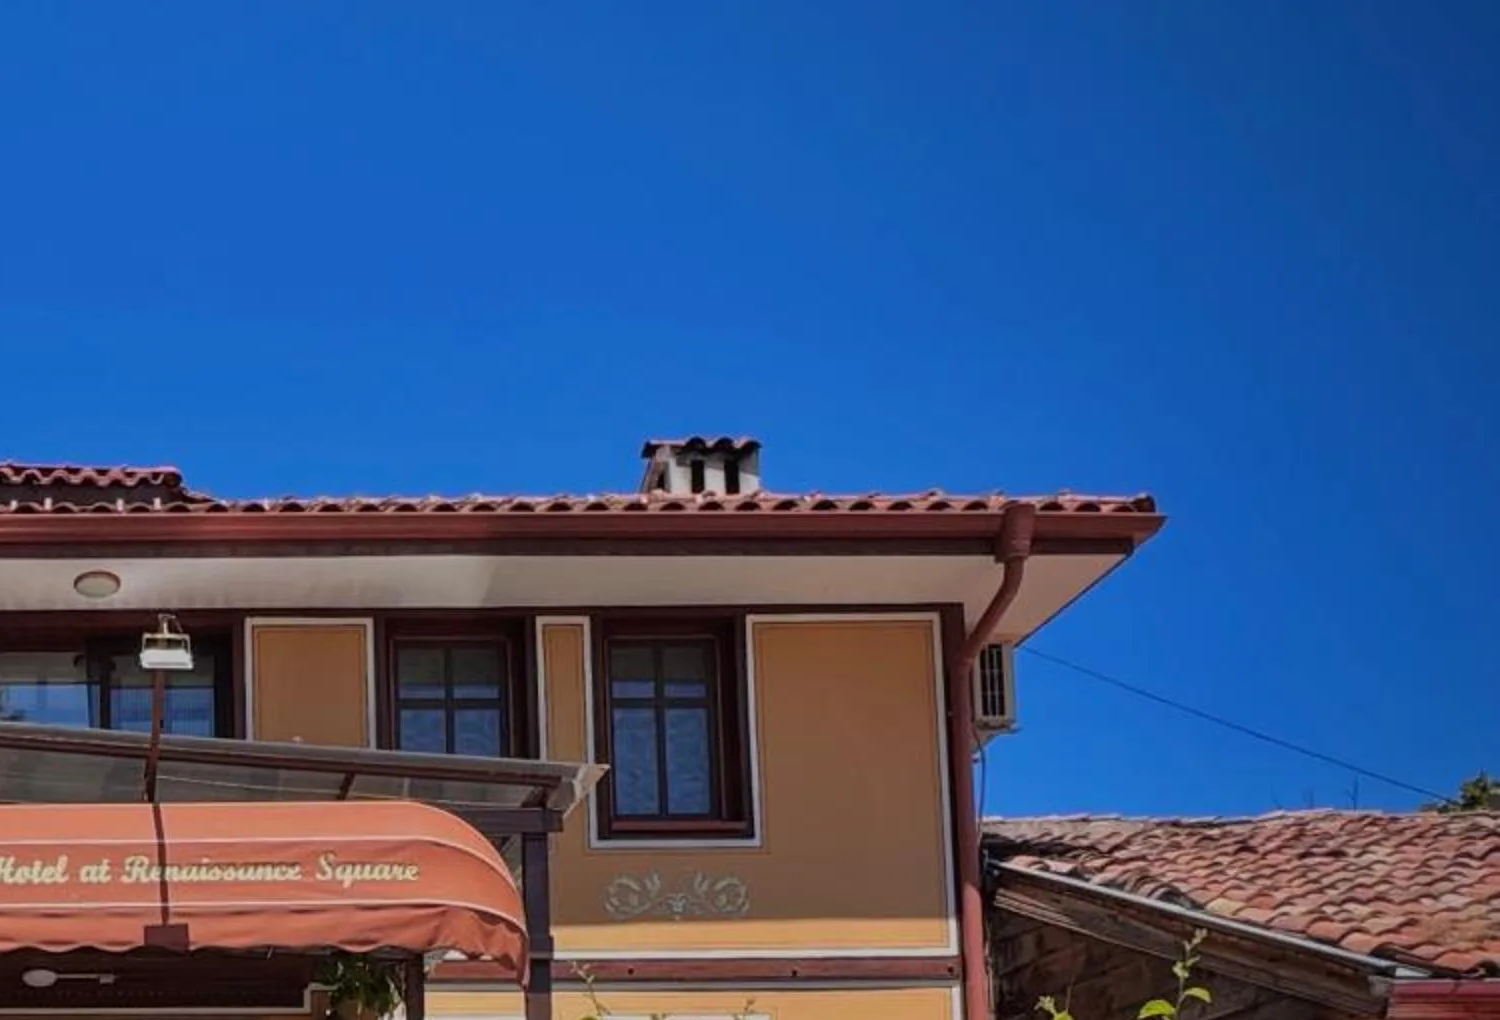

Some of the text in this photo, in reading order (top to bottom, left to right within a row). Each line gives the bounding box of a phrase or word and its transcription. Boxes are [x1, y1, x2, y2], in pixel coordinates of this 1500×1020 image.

[79, 859, 112, 883] at
[120, 854, 302, 884] Renaissance
[315, 852, 420, 886] Square
